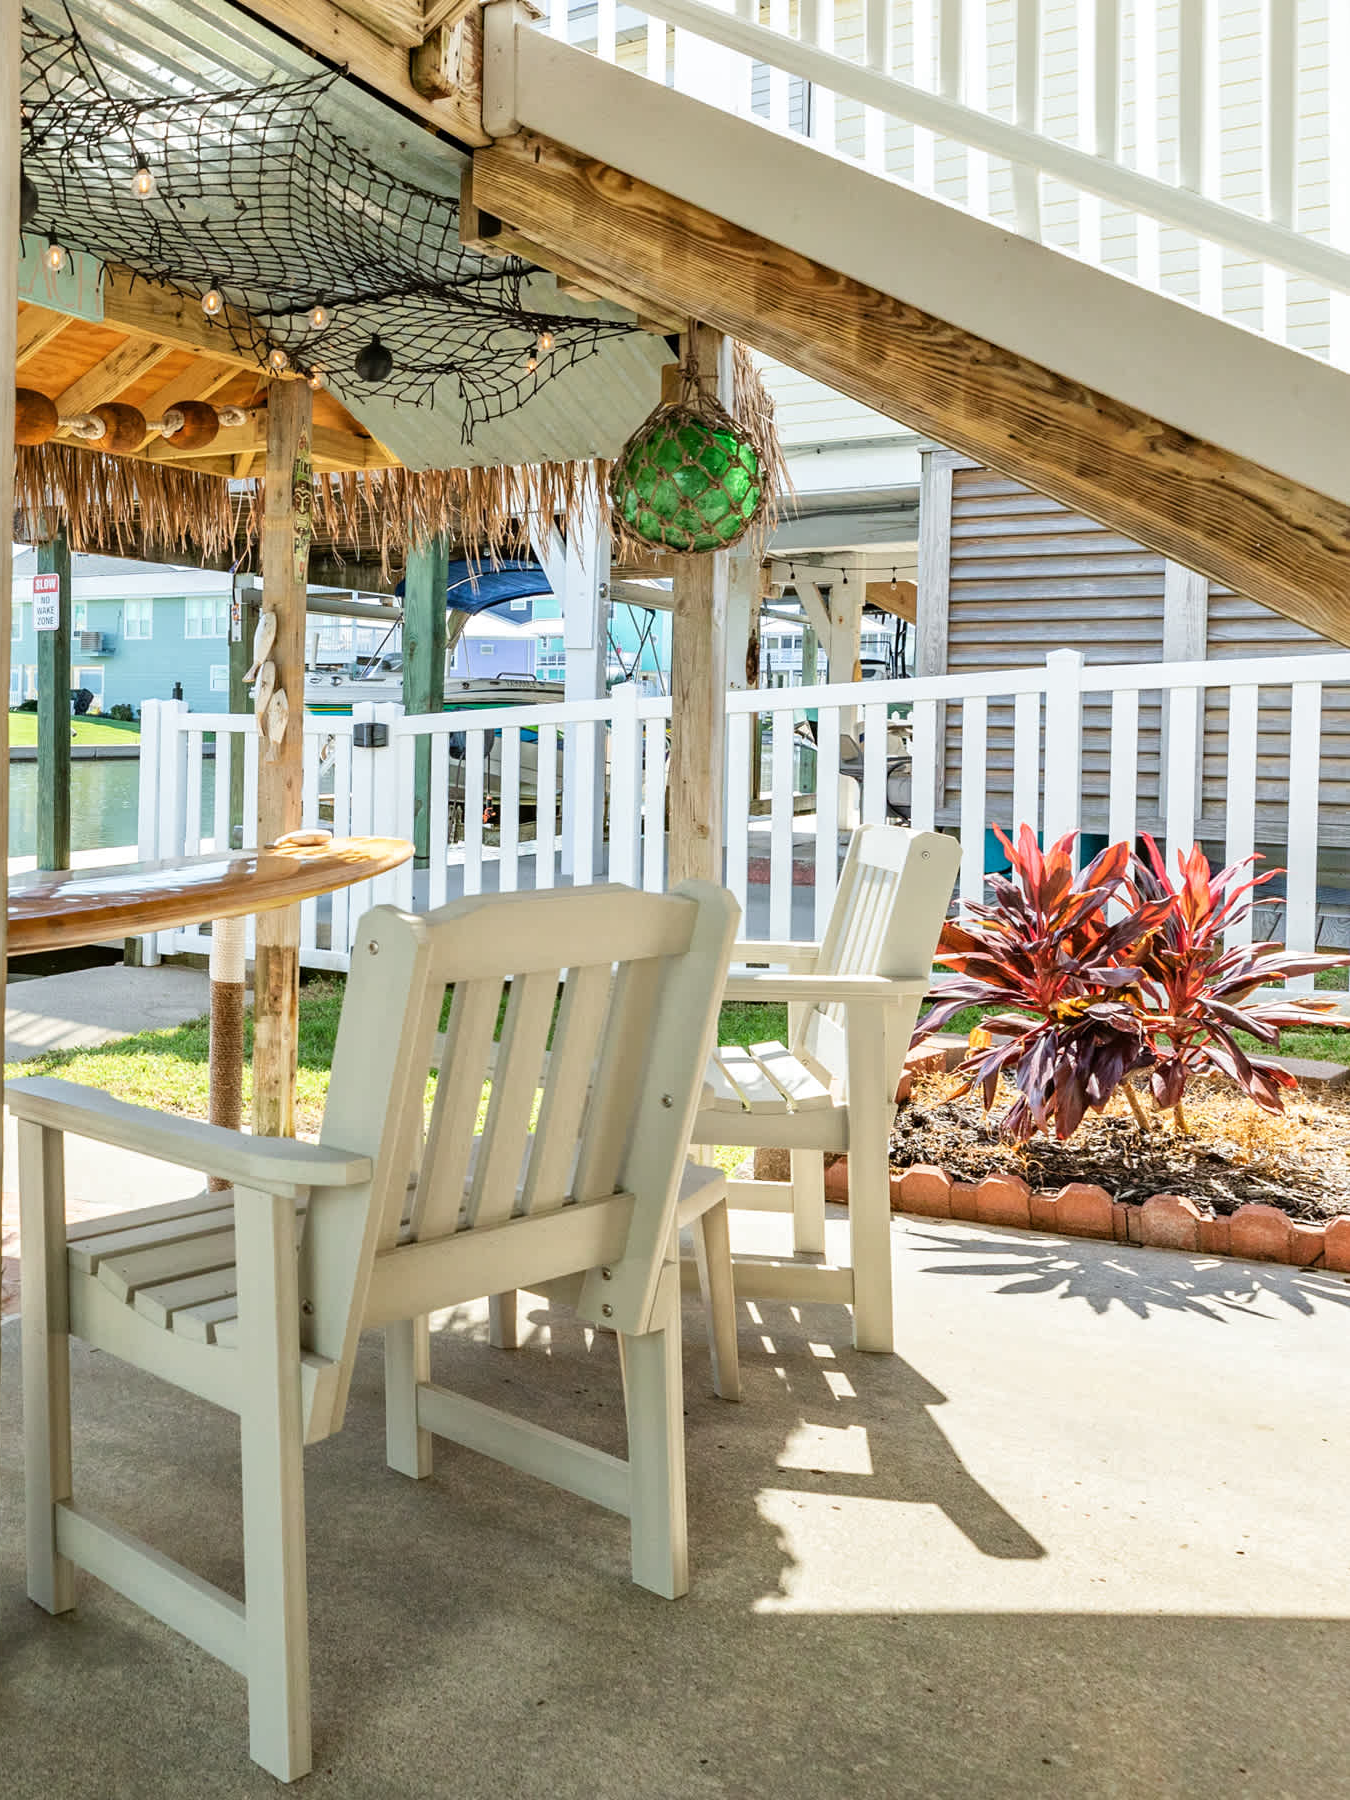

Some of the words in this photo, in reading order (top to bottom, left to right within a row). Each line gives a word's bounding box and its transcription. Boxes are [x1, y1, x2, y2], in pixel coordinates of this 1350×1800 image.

[36, 579, 56, 590] SLOW
[41, 596, 50, 604] NO
[37, 607, 54, 615] WAKE
[37, 616, 53, 625] ZONE
